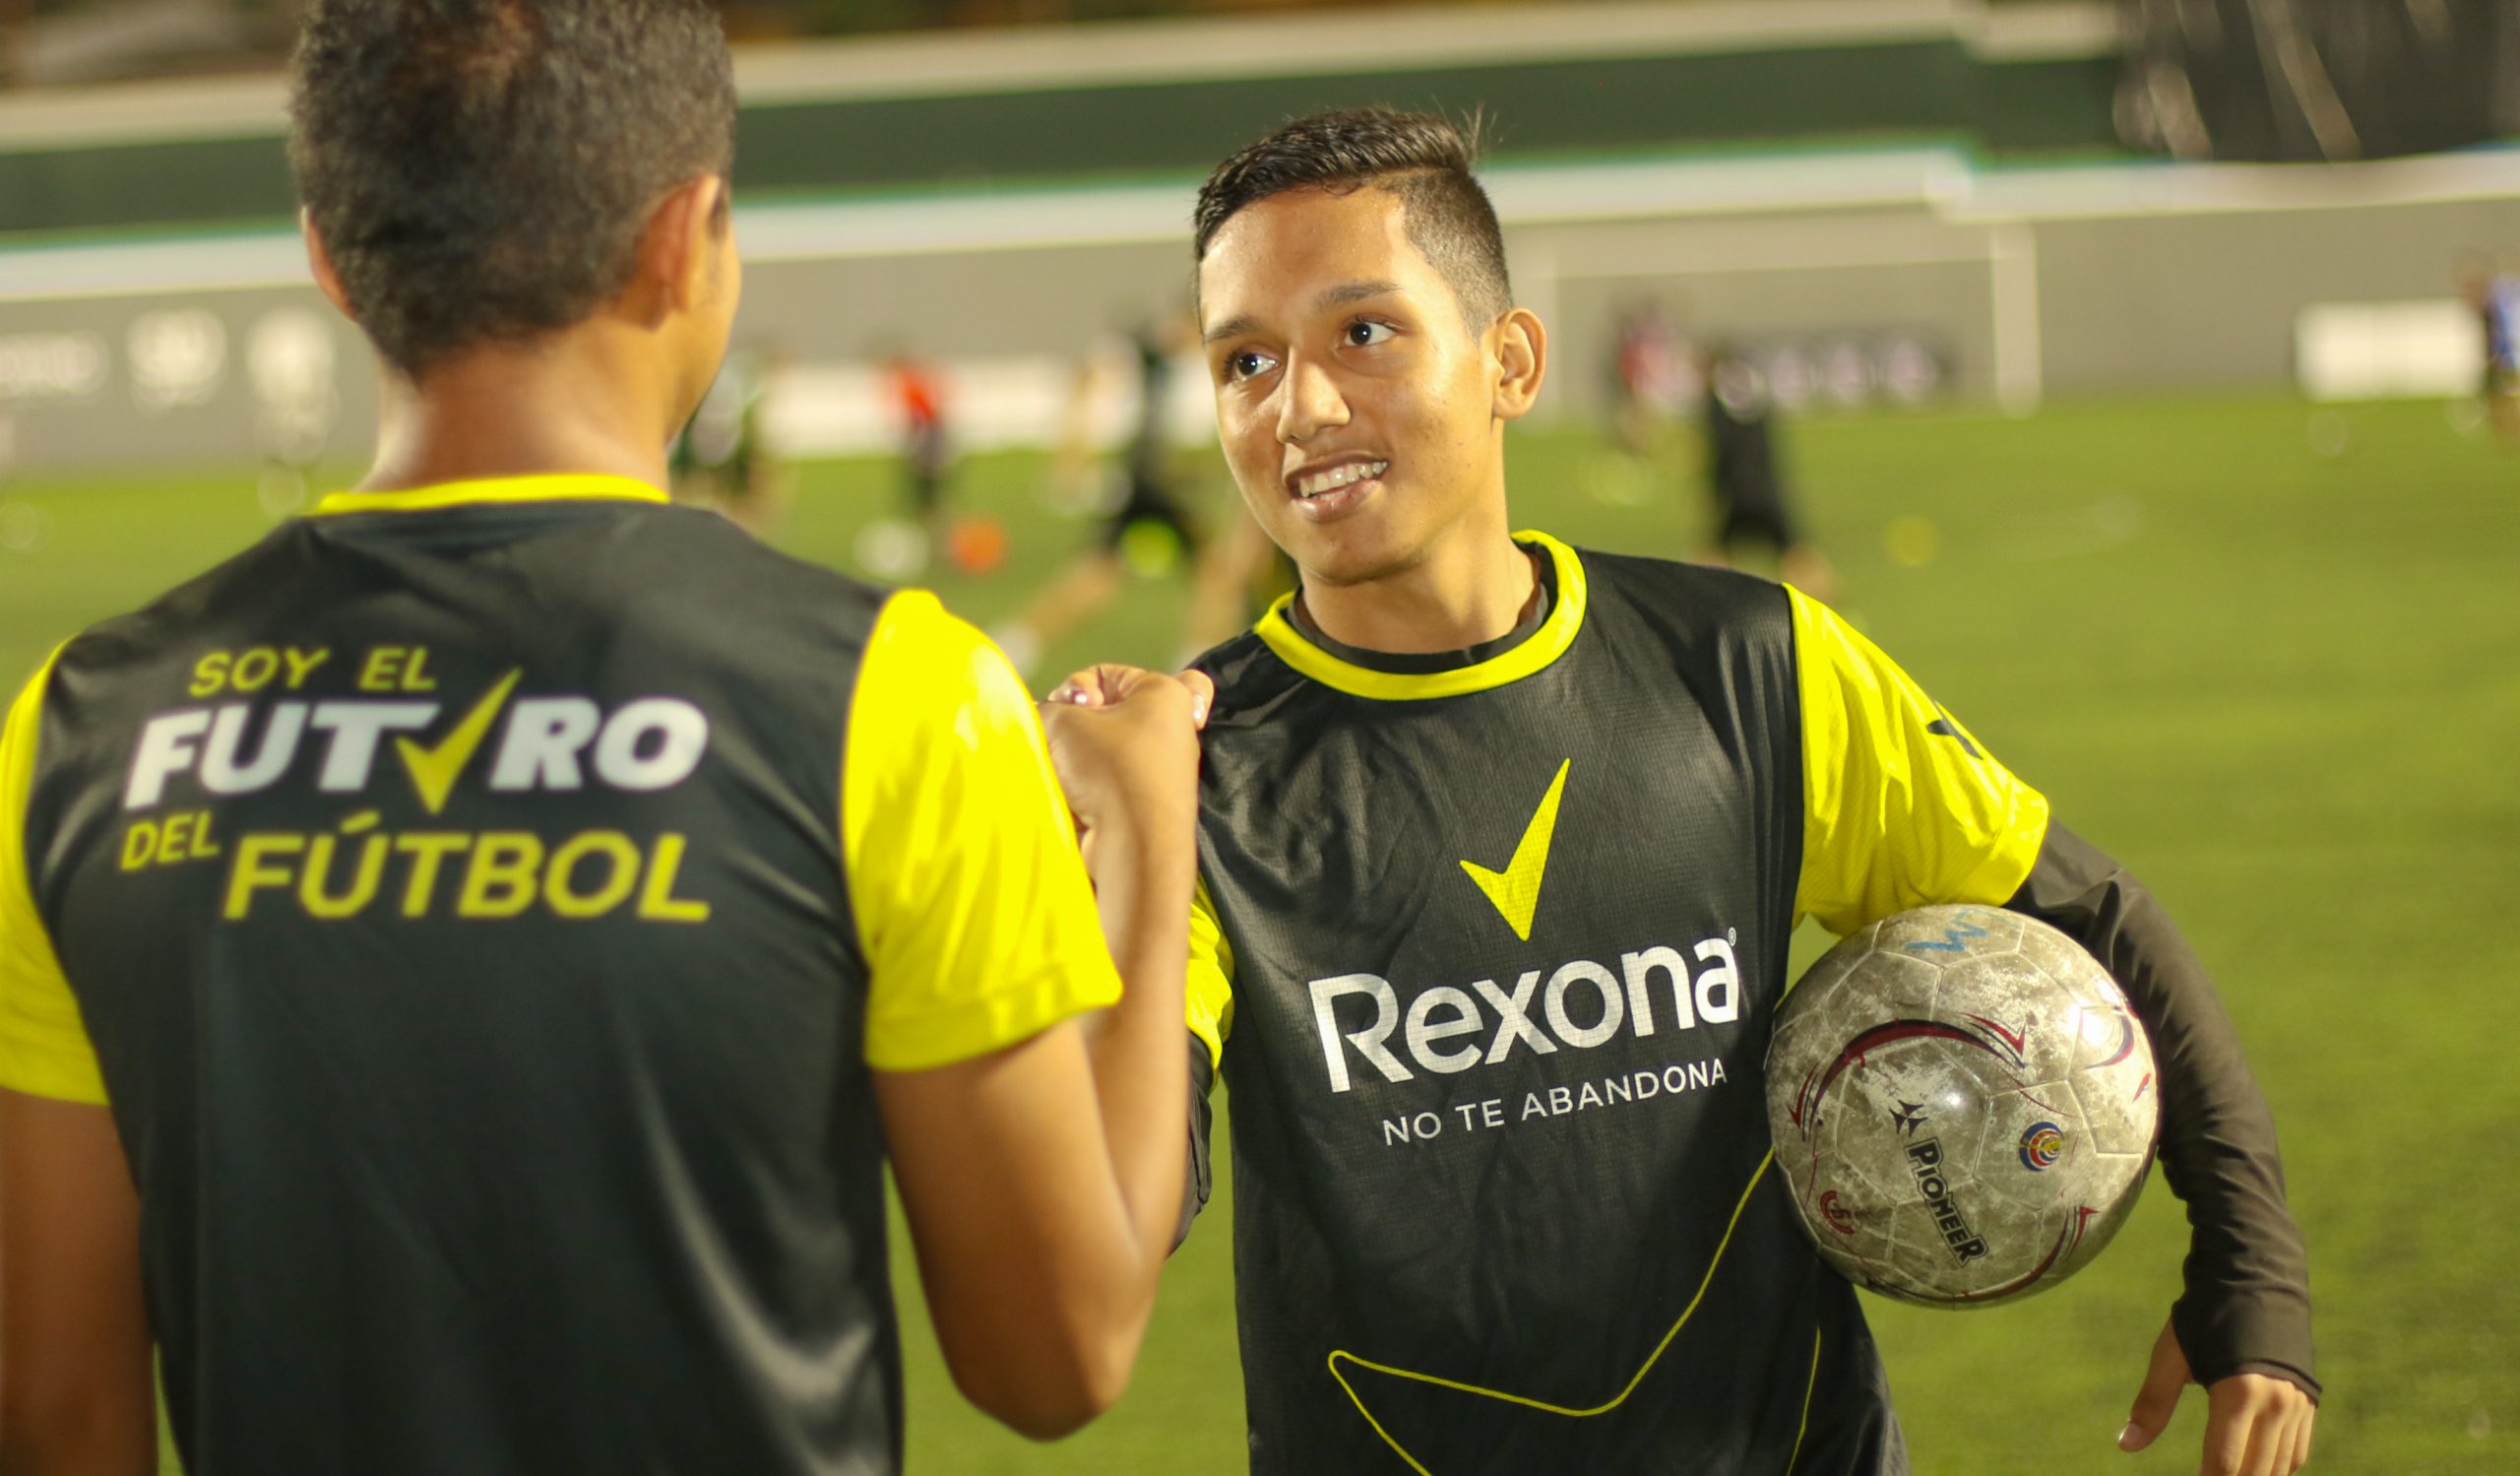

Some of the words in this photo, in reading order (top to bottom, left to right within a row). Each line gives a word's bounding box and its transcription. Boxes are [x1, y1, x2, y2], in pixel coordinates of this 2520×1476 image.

[188, 648, 329, 697] SOY
[358, 647, 437, 690] EL
[120, 812, 220, 870] DEL
[223, 810, 711, 922] FÚTBOL
[1307, 937, 1739, 1093] Rexona
[1382, 1112, 1442, 1146] NO
[1454, 1099, 1506, 1134] TE
[1521, 1058, 1728, 1122] ABANDONA
[1905, 1136, 1988, 1268] PIONEER
